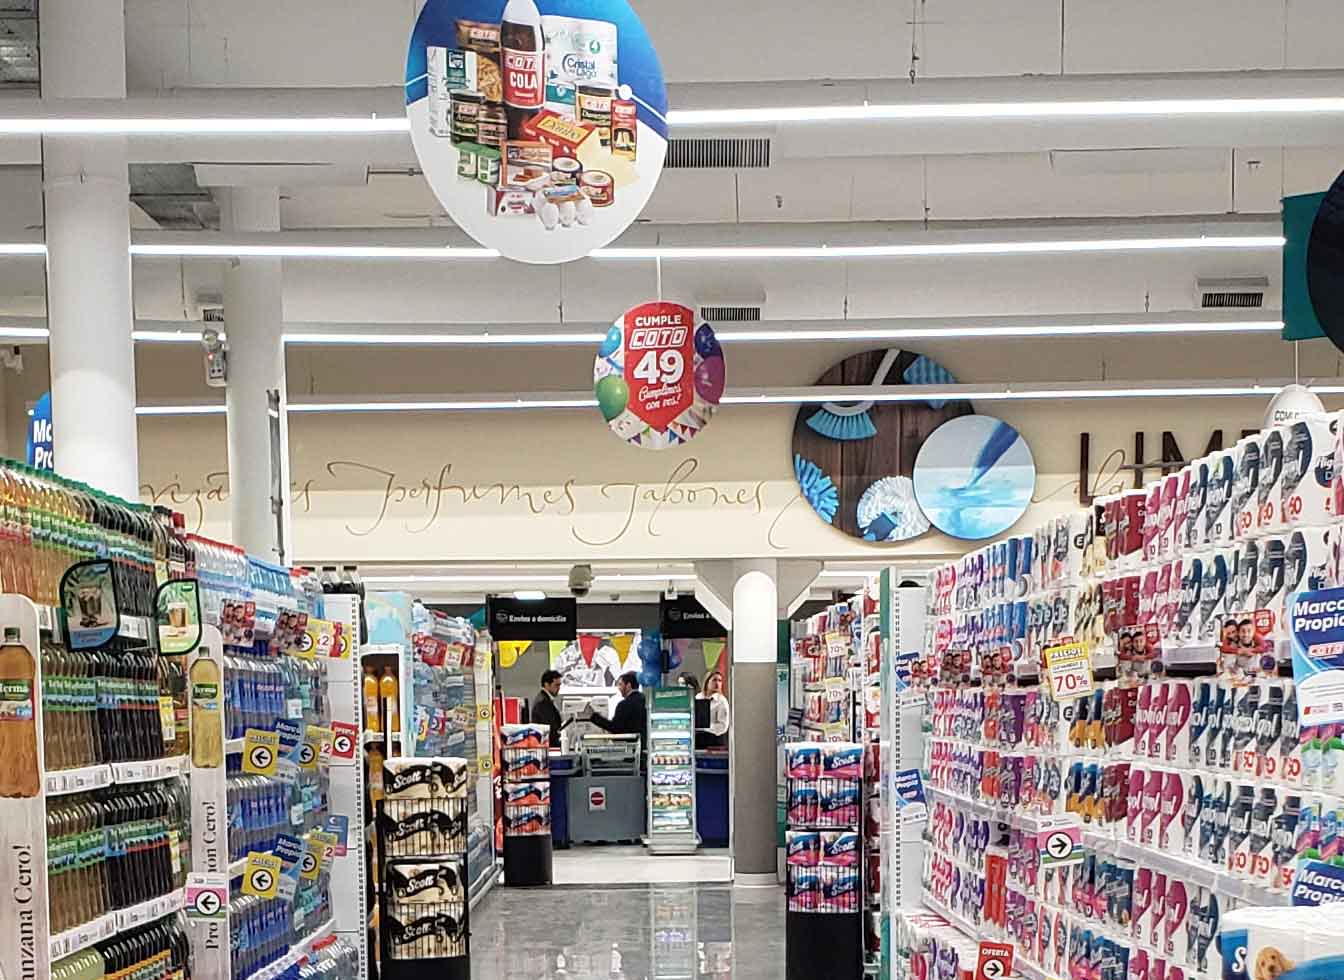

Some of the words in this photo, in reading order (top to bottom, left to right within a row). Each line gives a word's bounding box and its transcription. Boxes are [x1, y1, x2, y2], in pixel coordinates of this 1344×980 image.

[510, 72, 538, 89] COLA
[635, 314, 681, 327] CUMPLE
[630, 326, 688, 349] COTO
[633, 349, 685, 385] 49
[0, 681, 30, 697] Terma
[1054, 671, 1089, 693] 70%
[393, 769, 422, 789] Scott
[13, 844, 33, 908] Cero!
[407, 874, 434, 893] Scott
[981, 948, 1010, 958] OFERTA
